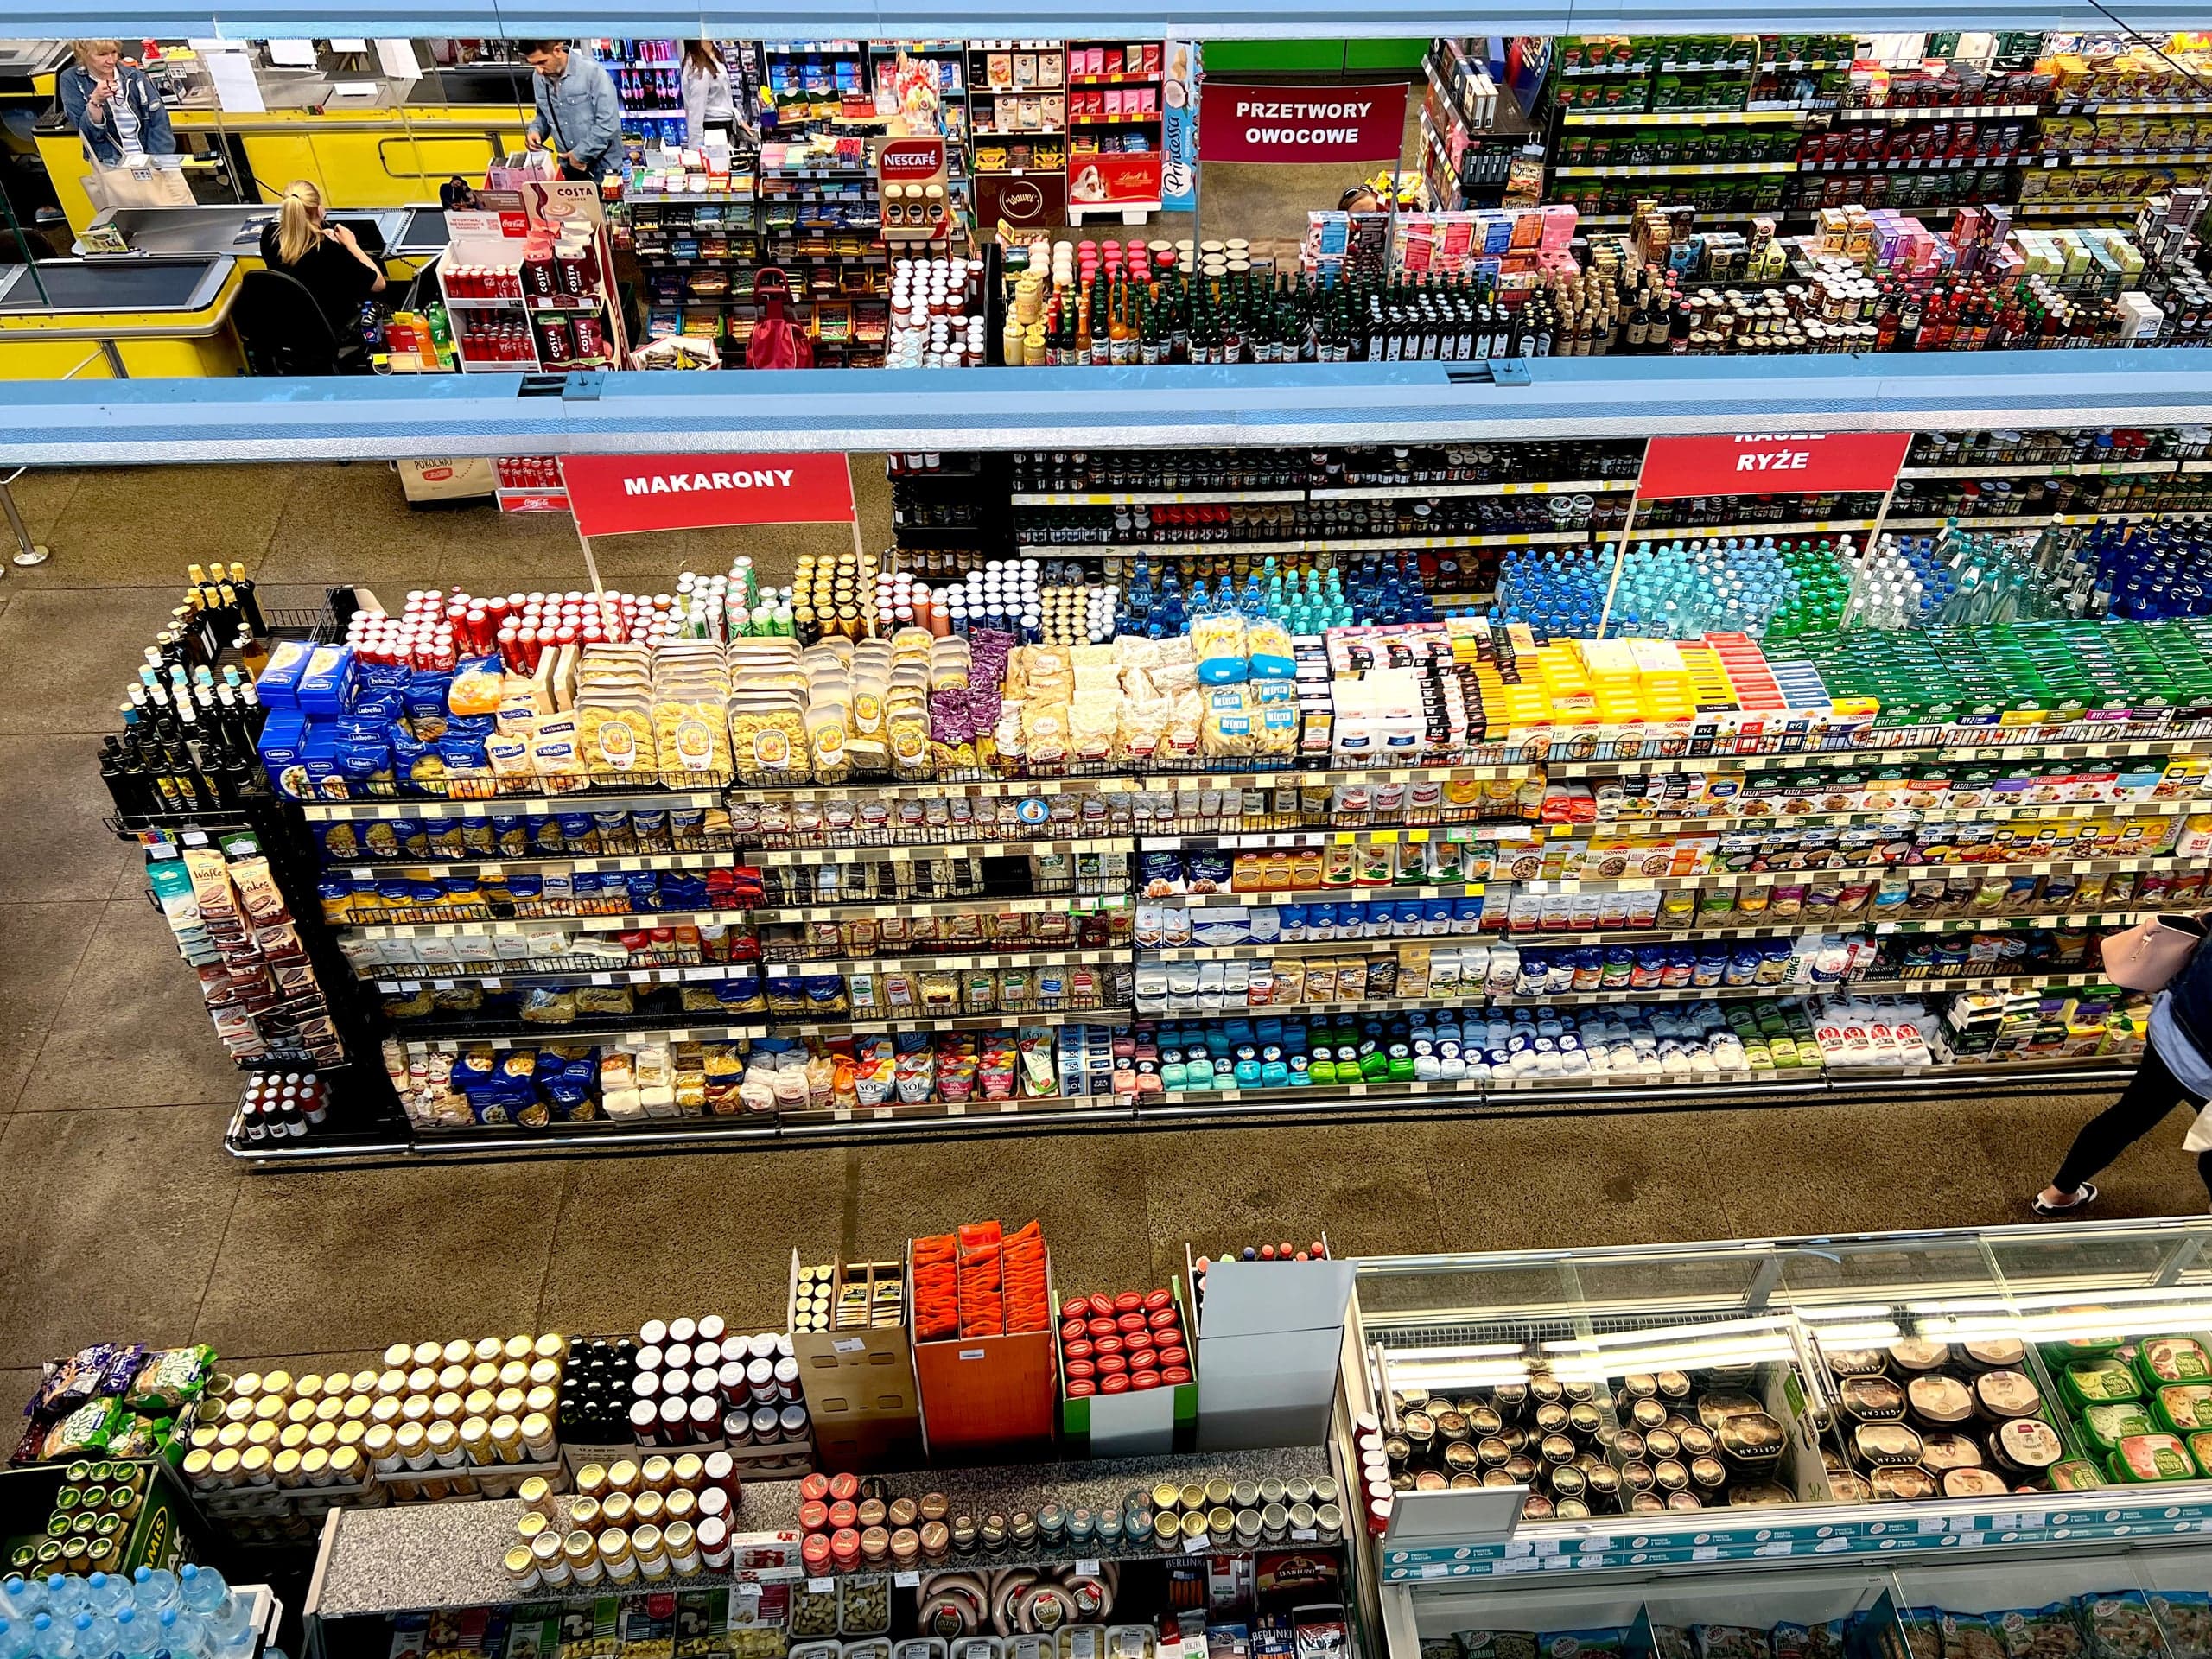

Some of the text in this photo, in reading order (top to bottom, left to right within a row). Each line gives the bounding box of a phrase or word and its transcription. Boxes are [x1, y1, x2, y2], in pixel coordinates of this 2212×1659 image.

[1236, 102, 1372, 118] PRZETWORY
[1245, 128, 1358, 144] OWOCOWE
[884, 150, 936, 166] NESCAFÉ
[1163, 117, 1183, 193] Princessa
[557, 188, 594, 197] COSTA
[539, 265, 548, 293] COSTA
[1736, 448, 1809, 471] RYŻE
[624, 469, 794, 496] MAKARONY
[493, 745, 523, 757] Lubella
[193, 869, 222, 881] Wafle
[240, 881, 270, 895] Cakes
[1739, 1446, 1777, 1455] GRYCAN
